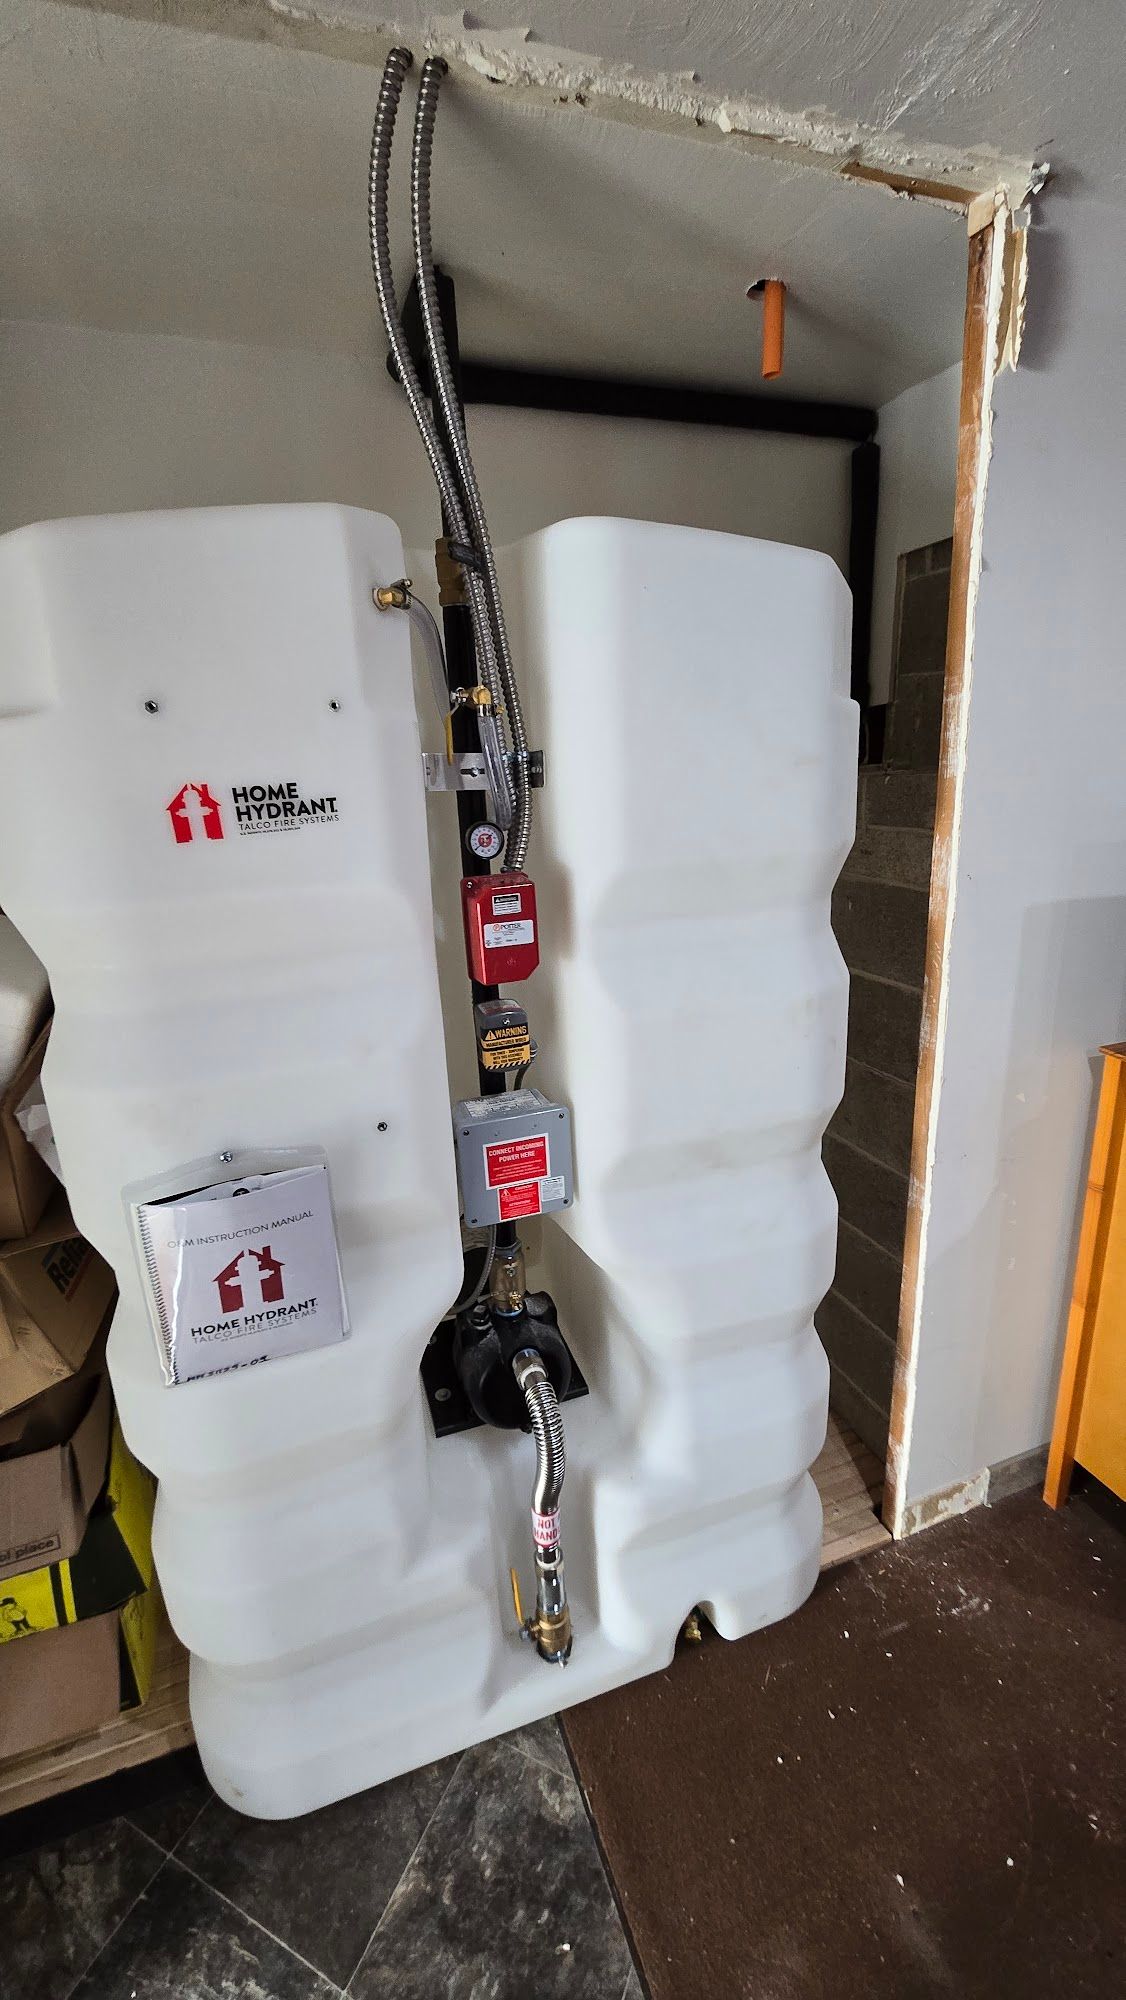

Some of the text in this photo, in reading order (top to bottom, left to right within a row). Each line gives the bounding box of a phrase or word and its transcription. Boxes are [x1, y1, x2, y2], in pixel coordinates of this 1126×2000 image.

[232, 782, 299, 804] HOME
[238, 821, 271, 831] TALCO
[274, 818, 296, 828] FIRE
[299, 814, 340, 825] SYSTEMS
[495, 1025, 527, 1039] WARNING
[488, 1140, 544, 1157] CONNECT INCOMING
[498, 1150, 536, 1163] POWER HERE
[196, 1223, 269, 1245] INSTRUCTION
[271, 1210, 314, 1229] MANUAL
[190, 1318, 241, 1337] HOME
[193, 1330, 233, 1344] TALCO
[237, 1322, 263, 1335] FIRE
[267, 1307, 317, 1327] SYSTEMS
[537, 1517, 556, 1530] NOT
[15, 1539, 55, 1559] place
